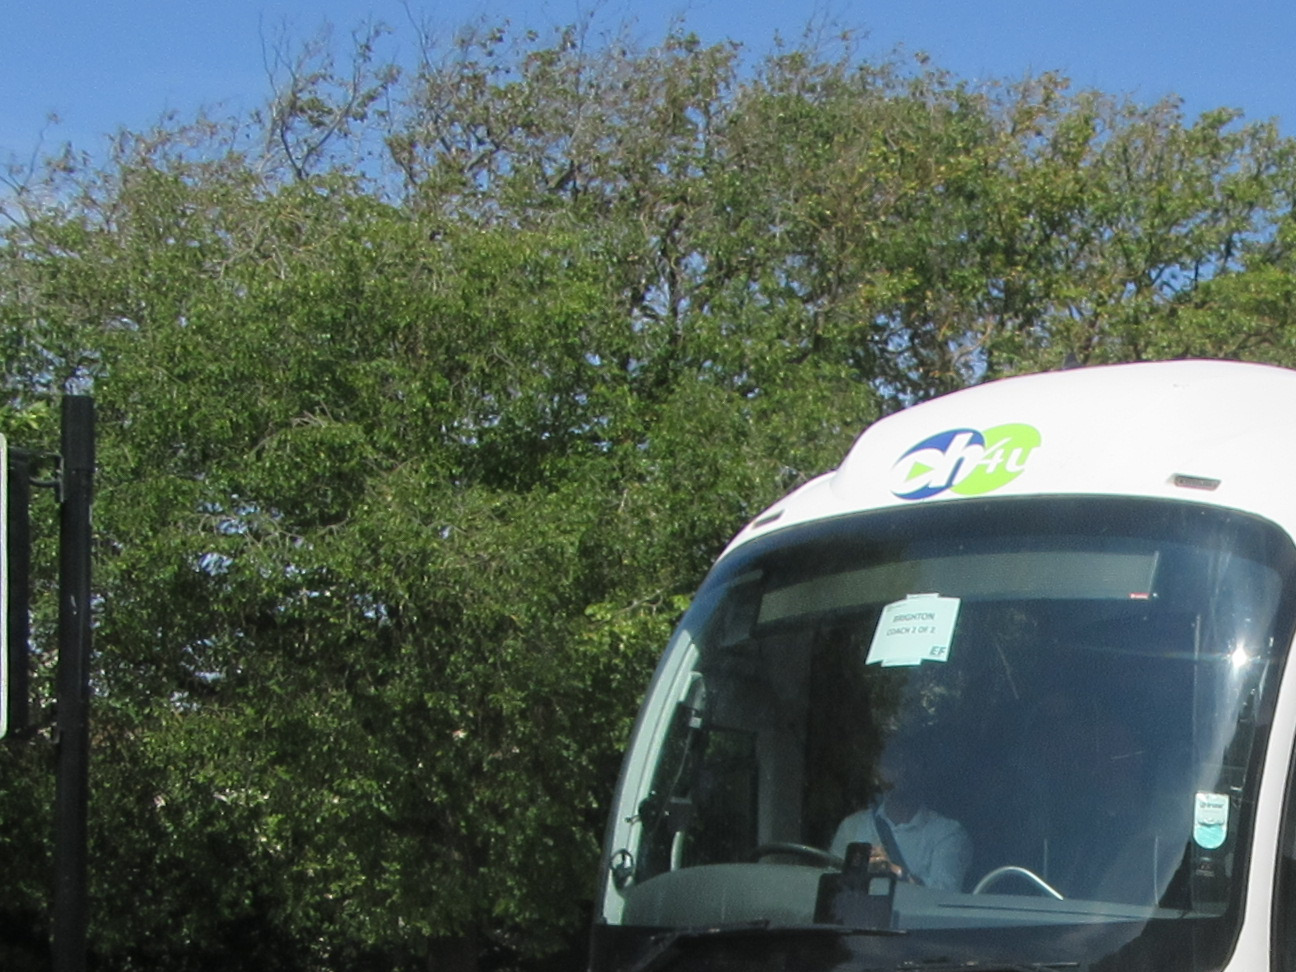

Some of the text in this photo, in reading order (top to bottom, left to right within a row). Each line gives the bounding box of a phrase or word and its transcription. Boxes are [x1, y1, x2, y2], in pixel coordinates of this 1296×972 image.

[892, 612, 936, 623] BRIGHTON
[886, 626, 910, 636] COACH
[918, 625, 929, 634] OF
